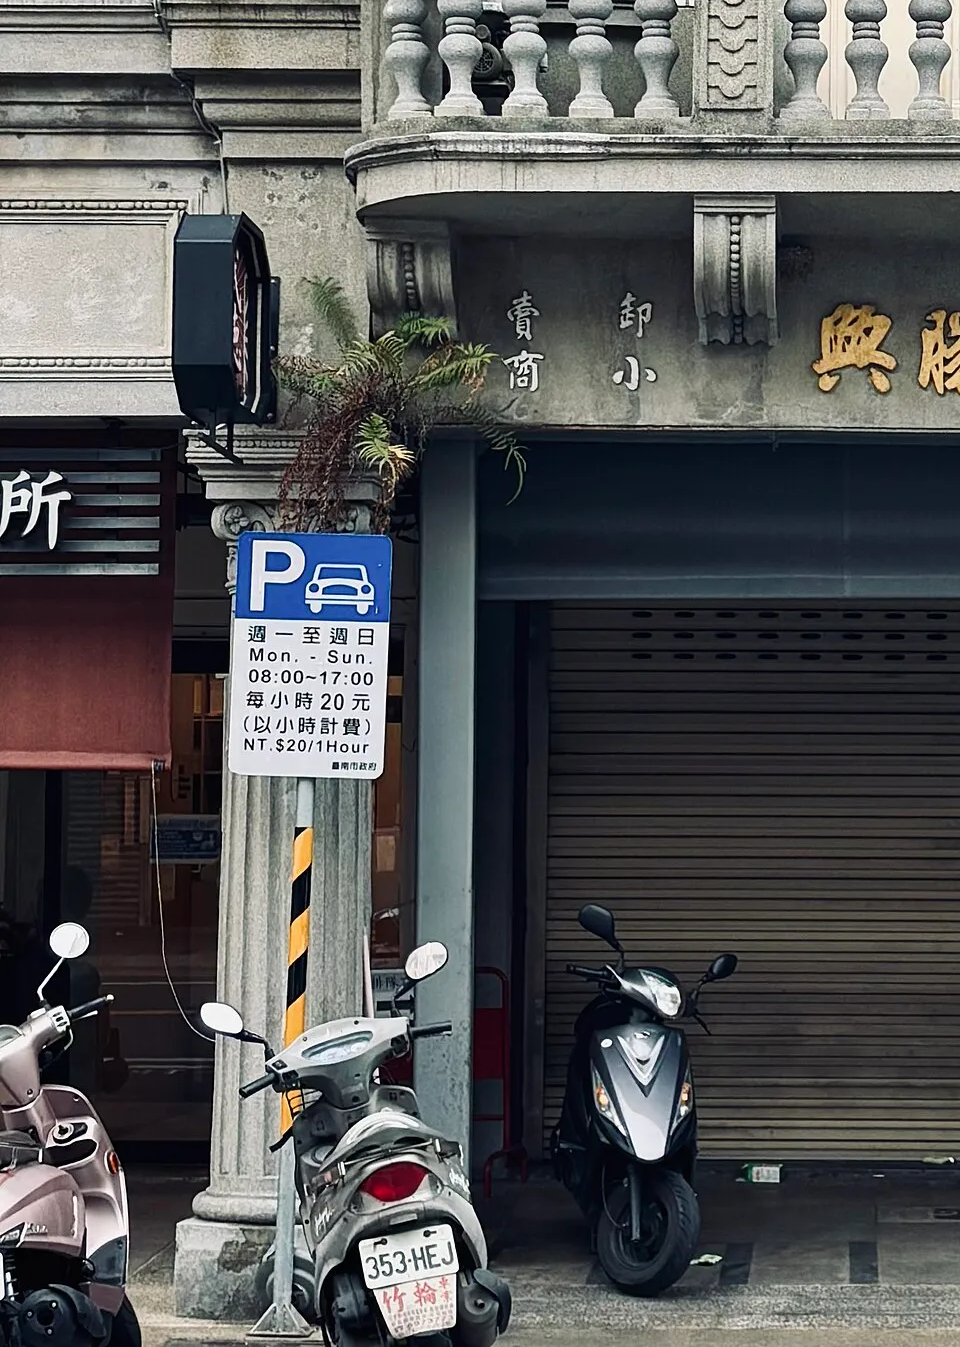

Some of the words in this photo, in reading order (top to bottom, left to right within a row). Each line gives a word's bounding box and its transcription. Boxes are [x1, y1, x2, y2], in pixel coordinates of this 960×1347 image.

[0, 469, 71, 550] 所
[249, 539, 306, 612] P
[247, 625, 375, 646] 週一至週日
[249, 648, 298, 663] Mon.
[327, 650, 373, 665] Sun.
[248, 668, 374, 686] 08:00~17:00
[244, 738, 369, 754] NT.$20/1Hour
